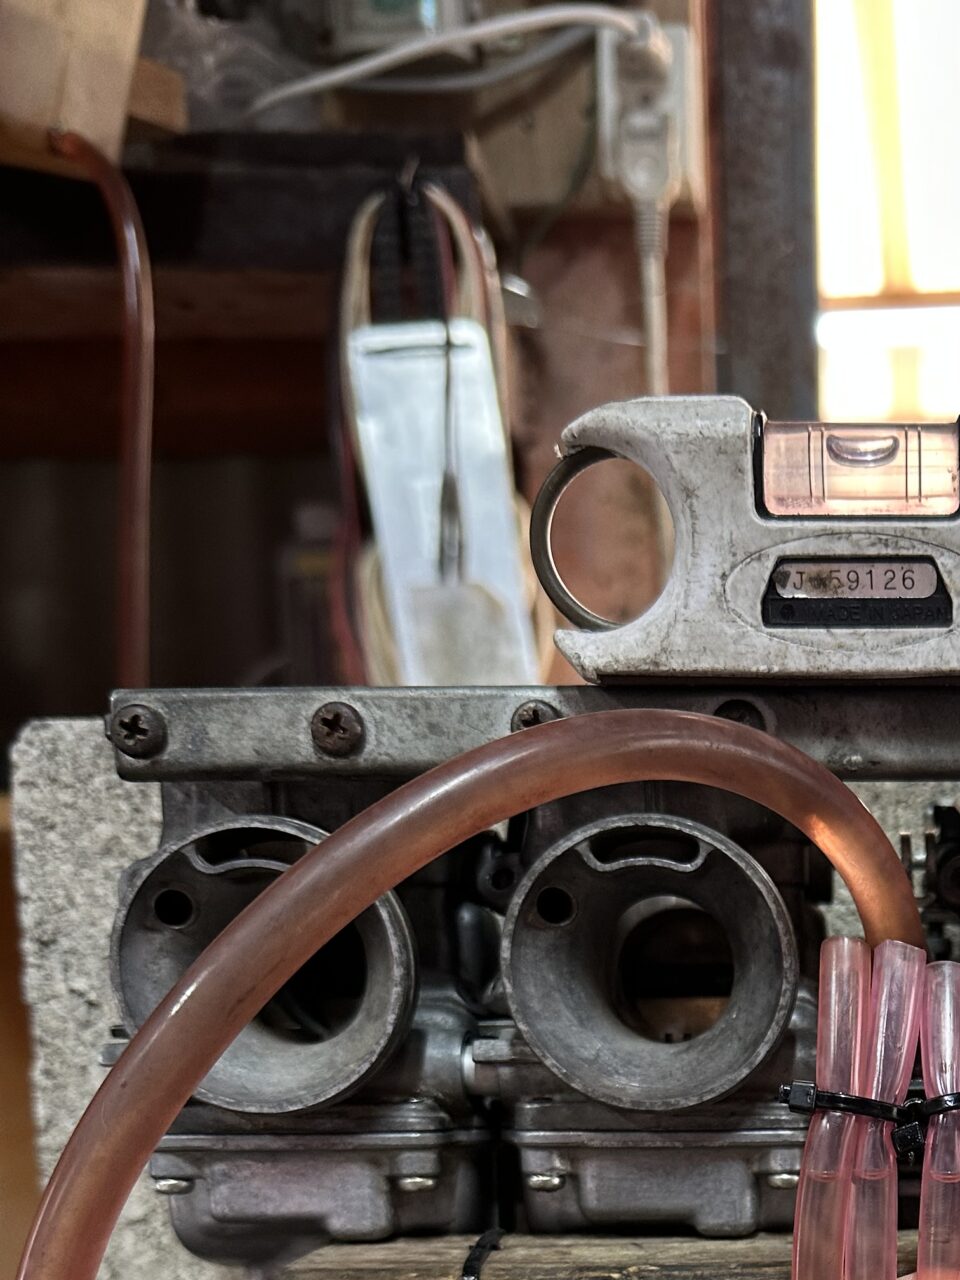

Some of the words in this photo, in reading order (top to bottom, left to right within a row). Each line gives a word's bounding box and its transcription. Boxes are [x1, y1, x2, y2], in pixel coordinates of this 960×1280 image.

[812, 603, 861, 621] MADE
[869, 603, 885, 621] IN
[892, 603, 948, 621] JAPAN
